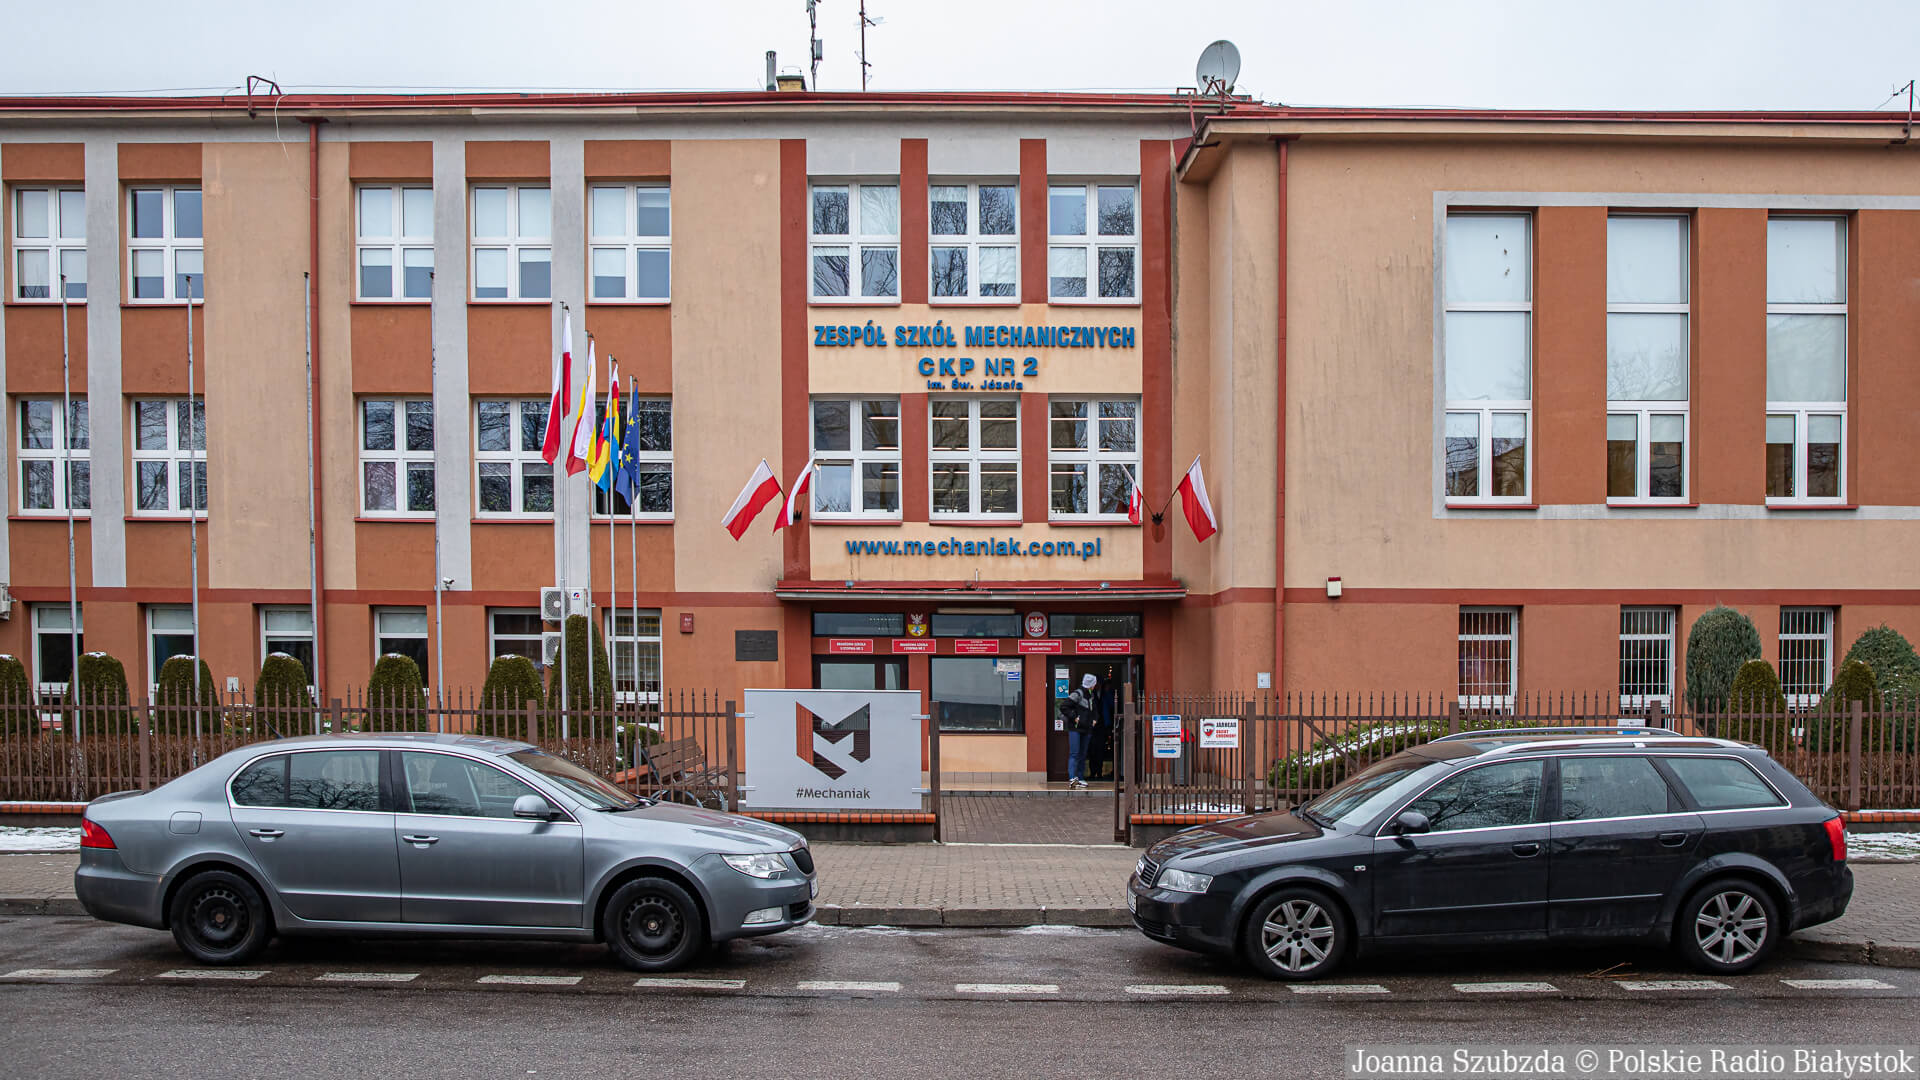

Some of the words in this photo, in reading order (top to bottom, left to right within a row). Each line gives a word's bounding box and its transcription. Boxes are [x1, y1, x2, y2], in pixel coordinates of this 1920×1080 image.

[814, 320, 887, 347] ZESPÓŁ
[895, 320, 957, 347] SZKÓŁ
[965, 326, 1135, 348] MECHANICZNYCH
[918, 357, 975, 376] CKP
[985, 358, 1015, 377] NR
[1023, 357, 1038, 377] 2
[980, 379, 1023, 390] Józefa
[846, 538, 1102, 559] www.mechaniak.com.pl
[796, 787, 871, 799] #Mechaniak
